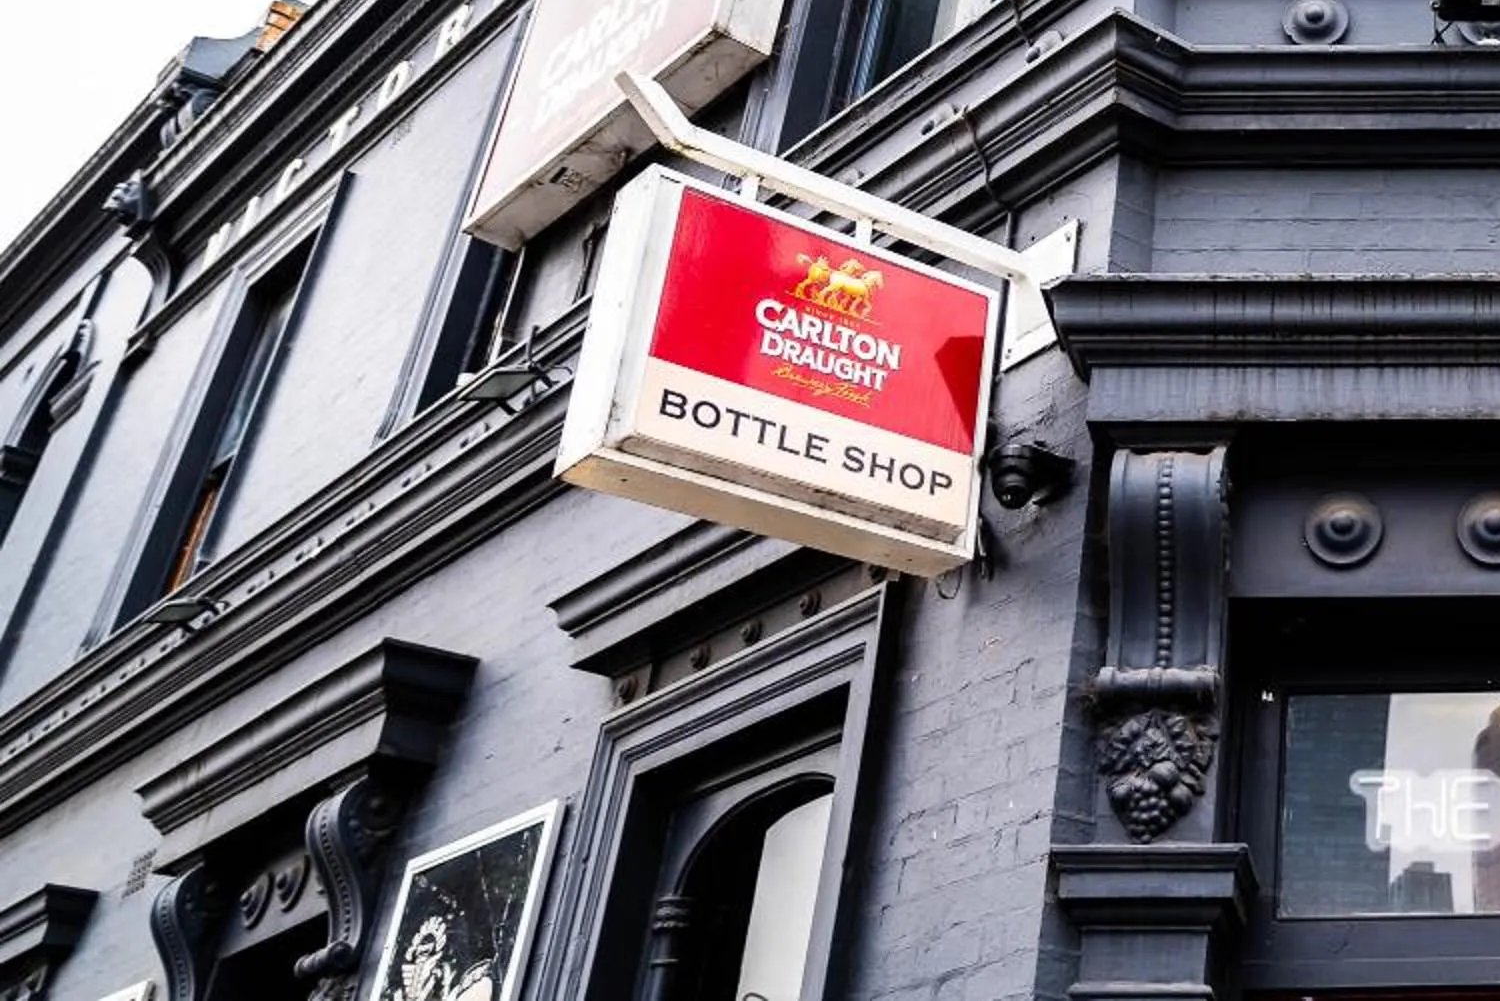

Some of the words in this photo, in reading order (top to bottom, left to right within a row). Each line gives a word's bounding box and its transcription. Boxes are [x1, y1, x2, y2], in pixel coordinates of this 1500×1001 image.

[755, 298, 902, 370] CARLTON
[760, 330, 888, 392] DRAUGHT
[659, 388, 831, 465] BOTTLE
[842, 445, 954, 497] SHOP
[1354, 773, 1491, 843] THE
